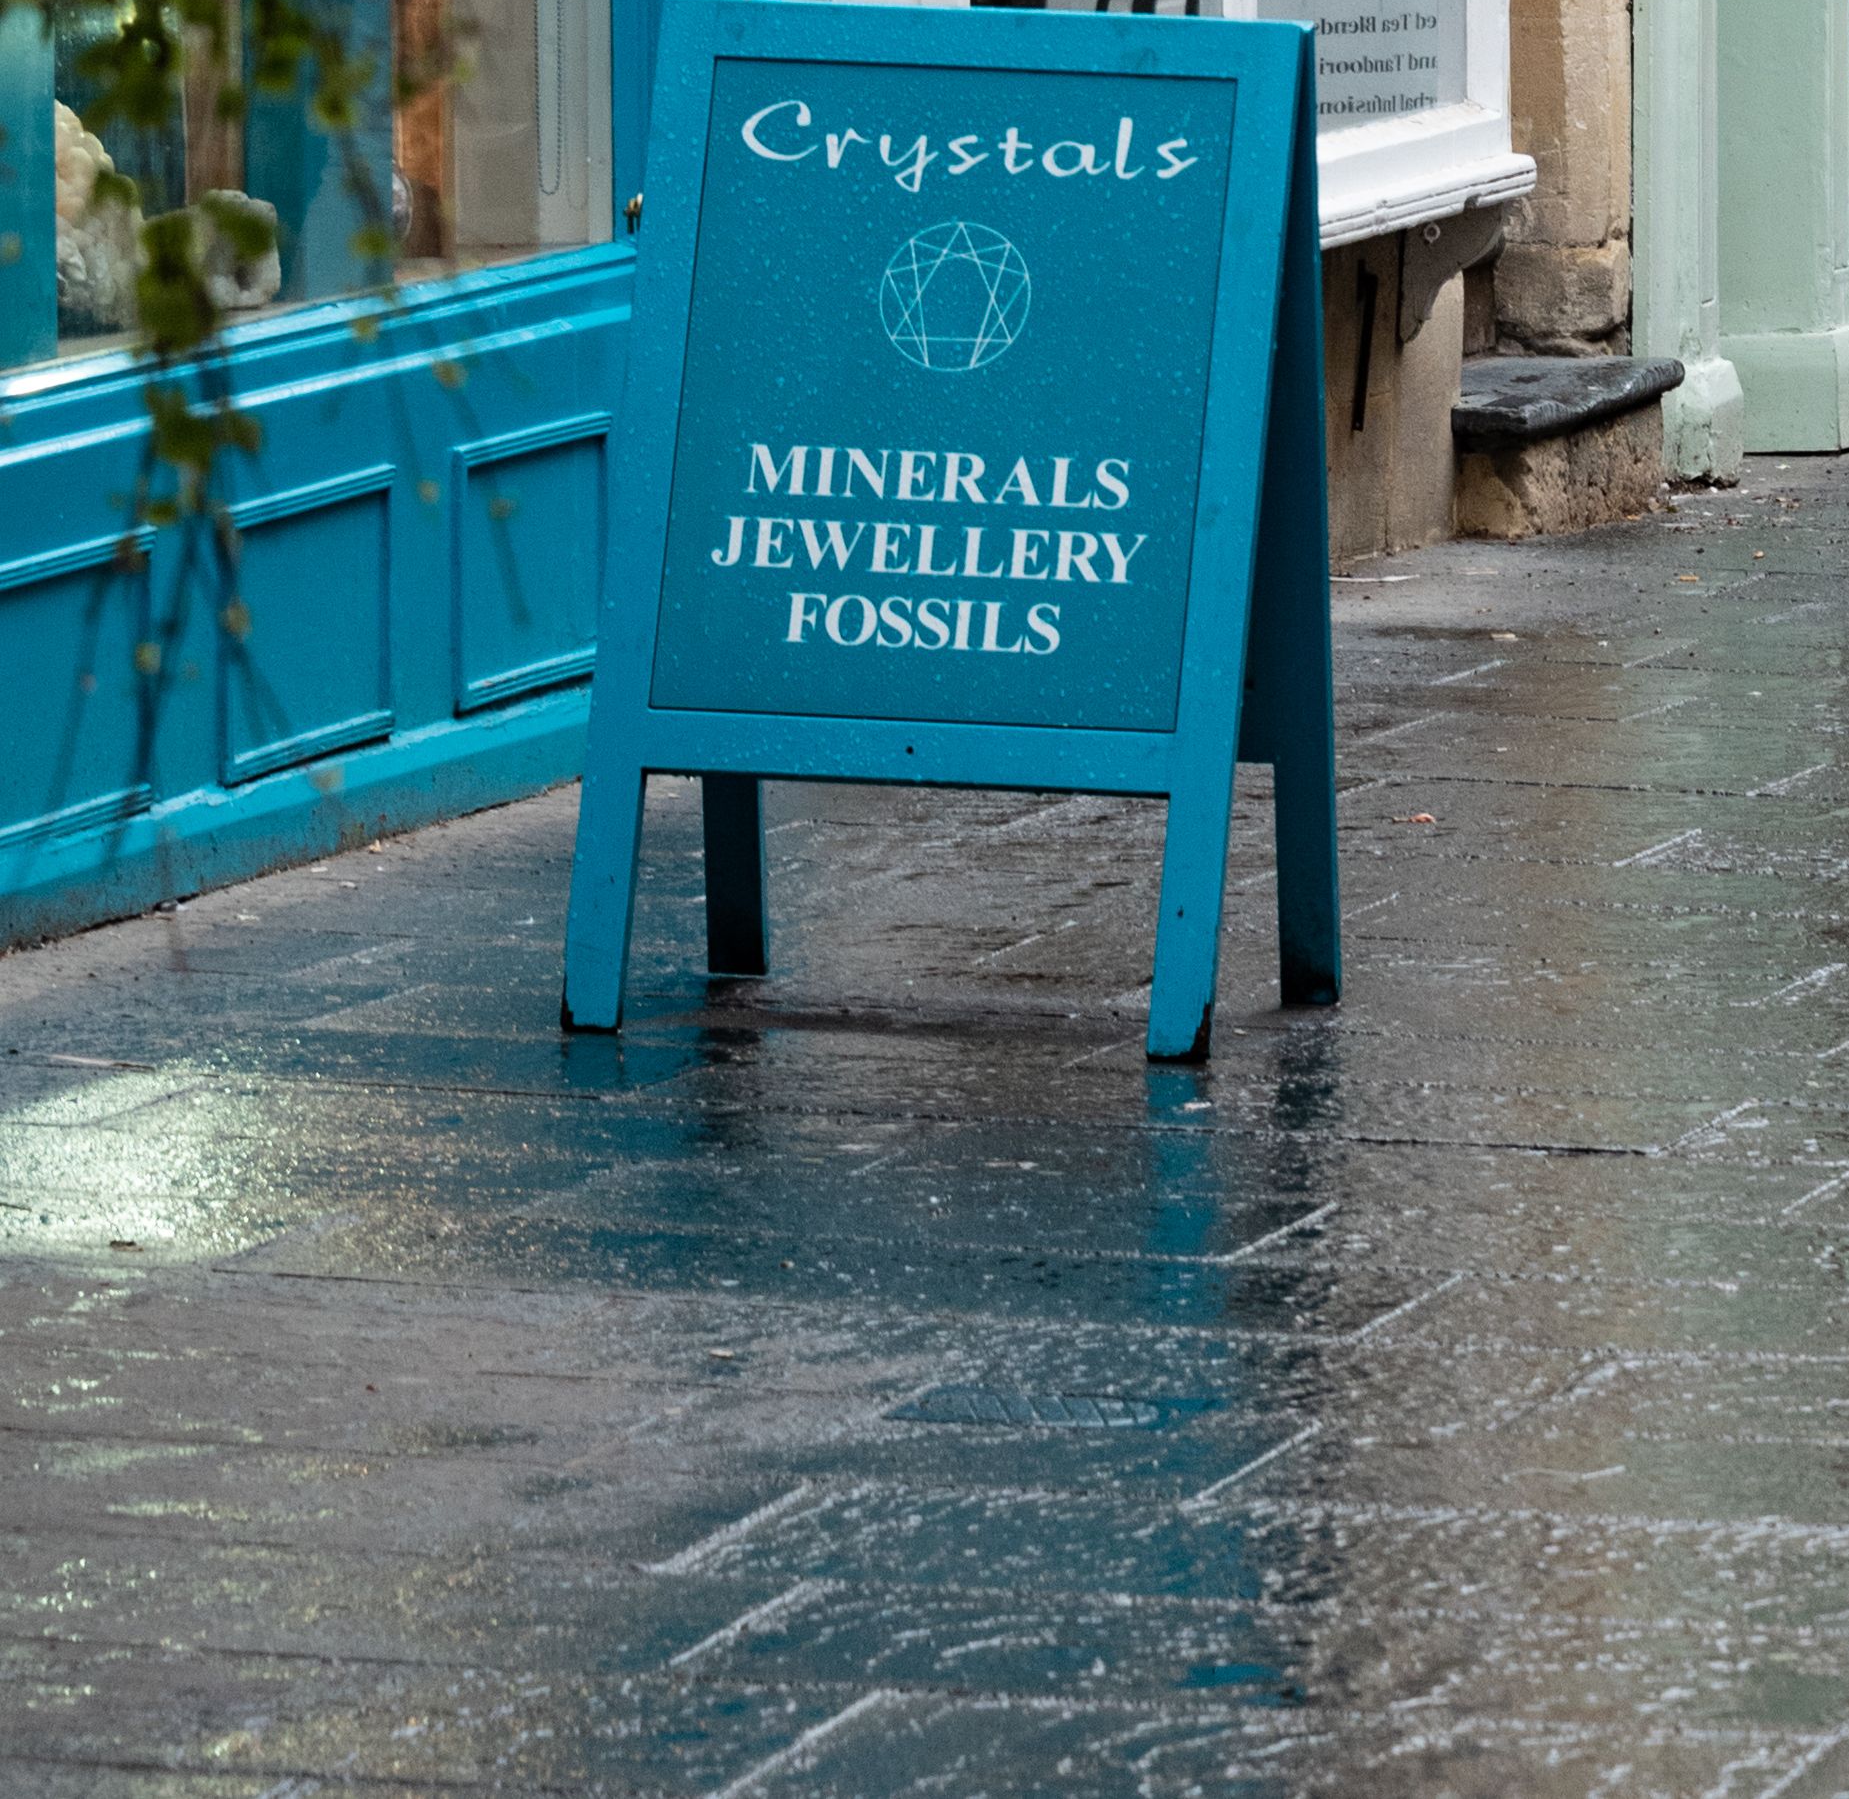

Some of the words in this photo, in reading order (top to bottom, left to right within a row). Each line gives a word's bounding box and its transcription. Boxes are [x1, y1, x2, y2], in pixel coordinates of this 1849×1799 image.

[740, 99, 1200, 194] Crystals
[743, 441, 1131, 510] MINERALS
[710, 514, 1149, 584] JEWELLERY
[783, 591, 1063, 656] FOSSILS
